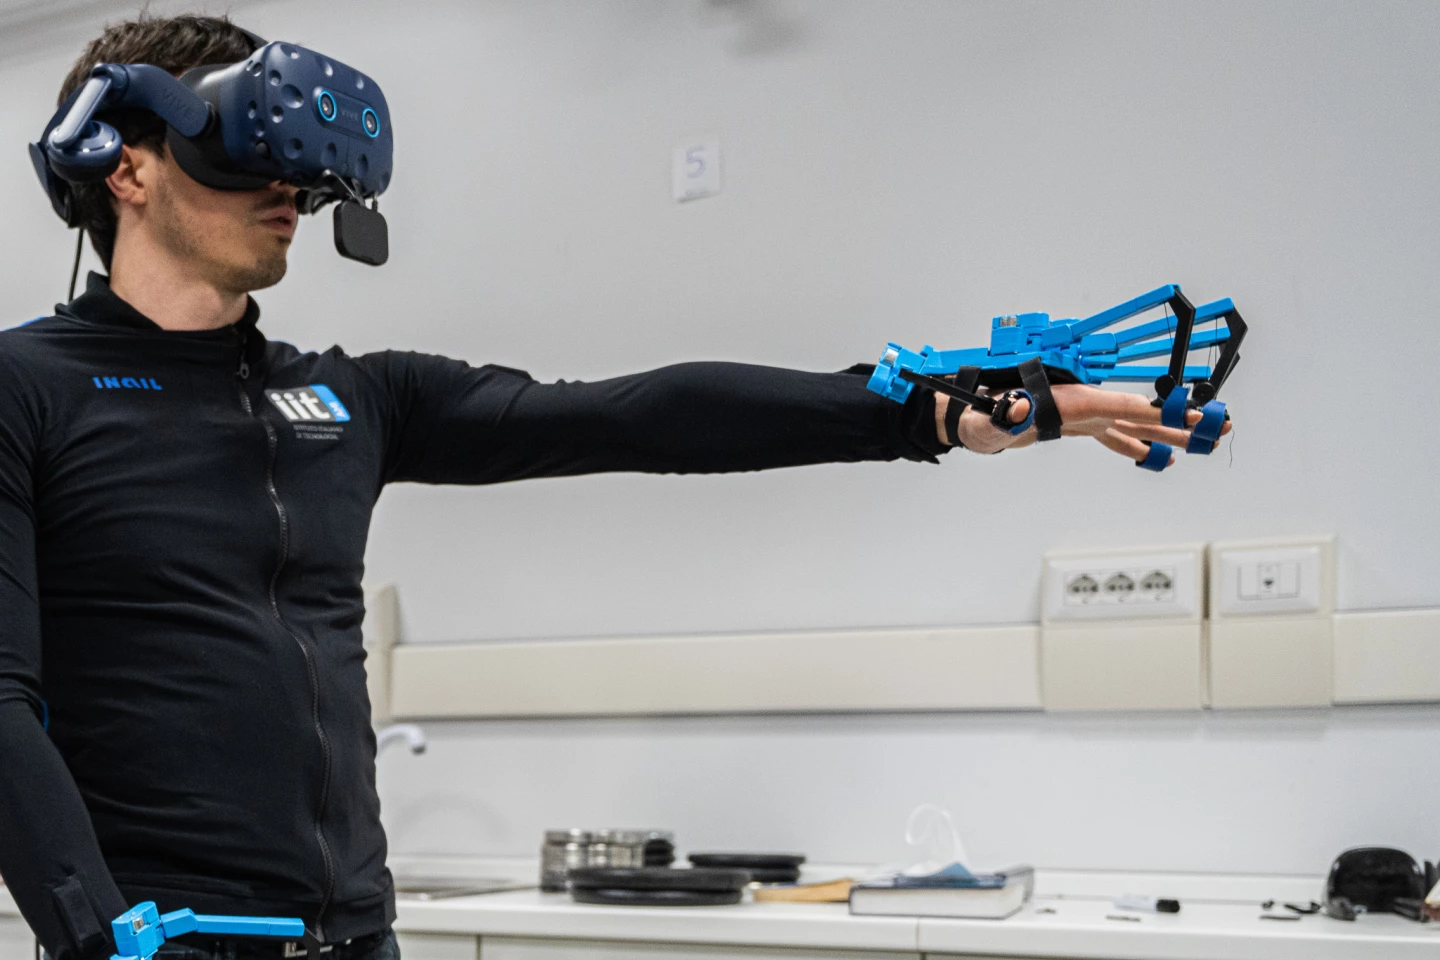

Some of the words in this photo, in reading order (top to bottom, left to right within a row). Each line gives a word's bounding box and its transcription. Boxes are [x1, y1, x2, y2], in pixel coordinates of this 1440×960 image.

[684, 145, 706, 179] 5
[92, 376, 163, 390] INAIL
[270, 391, 330, 419] iit
